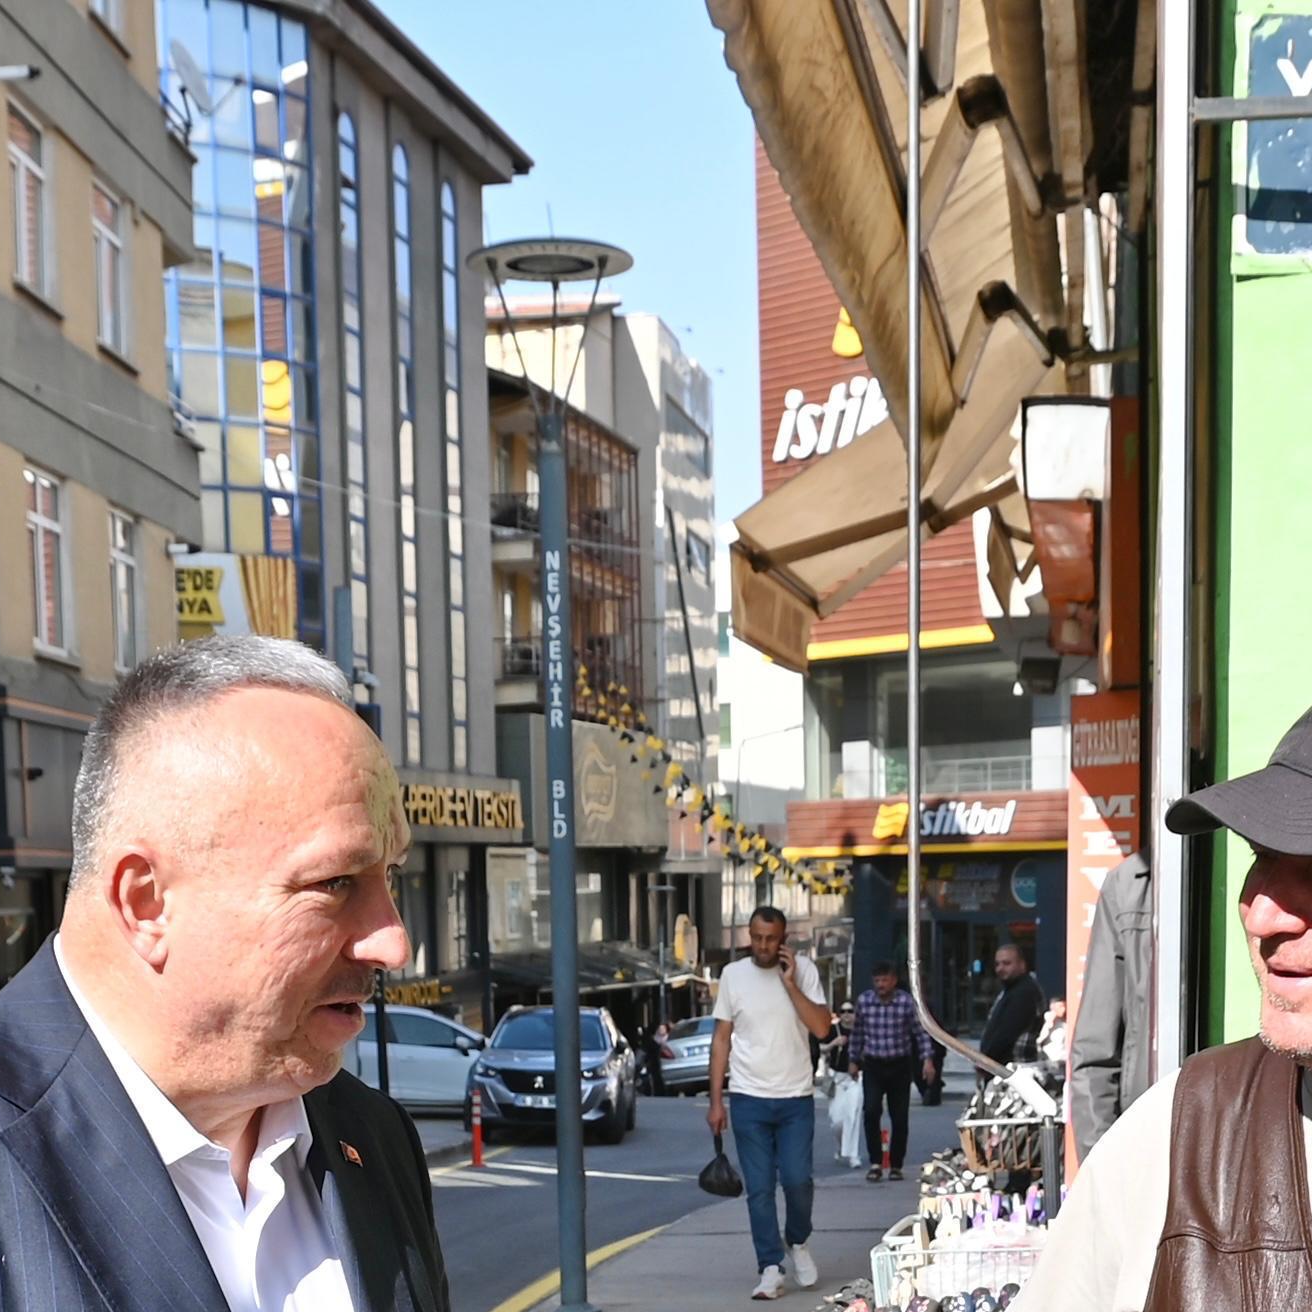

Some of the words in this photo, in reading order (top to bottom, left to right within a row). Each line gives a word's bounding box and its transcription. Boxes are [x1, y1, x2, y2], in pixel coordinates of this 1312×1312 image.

[772, 376, 889, 463] istik
[545, 551, 564, 729] NEVŞEHİR
[552, 780, 568, 839] BLD
[919, 800, 1017, 836] stikbal
